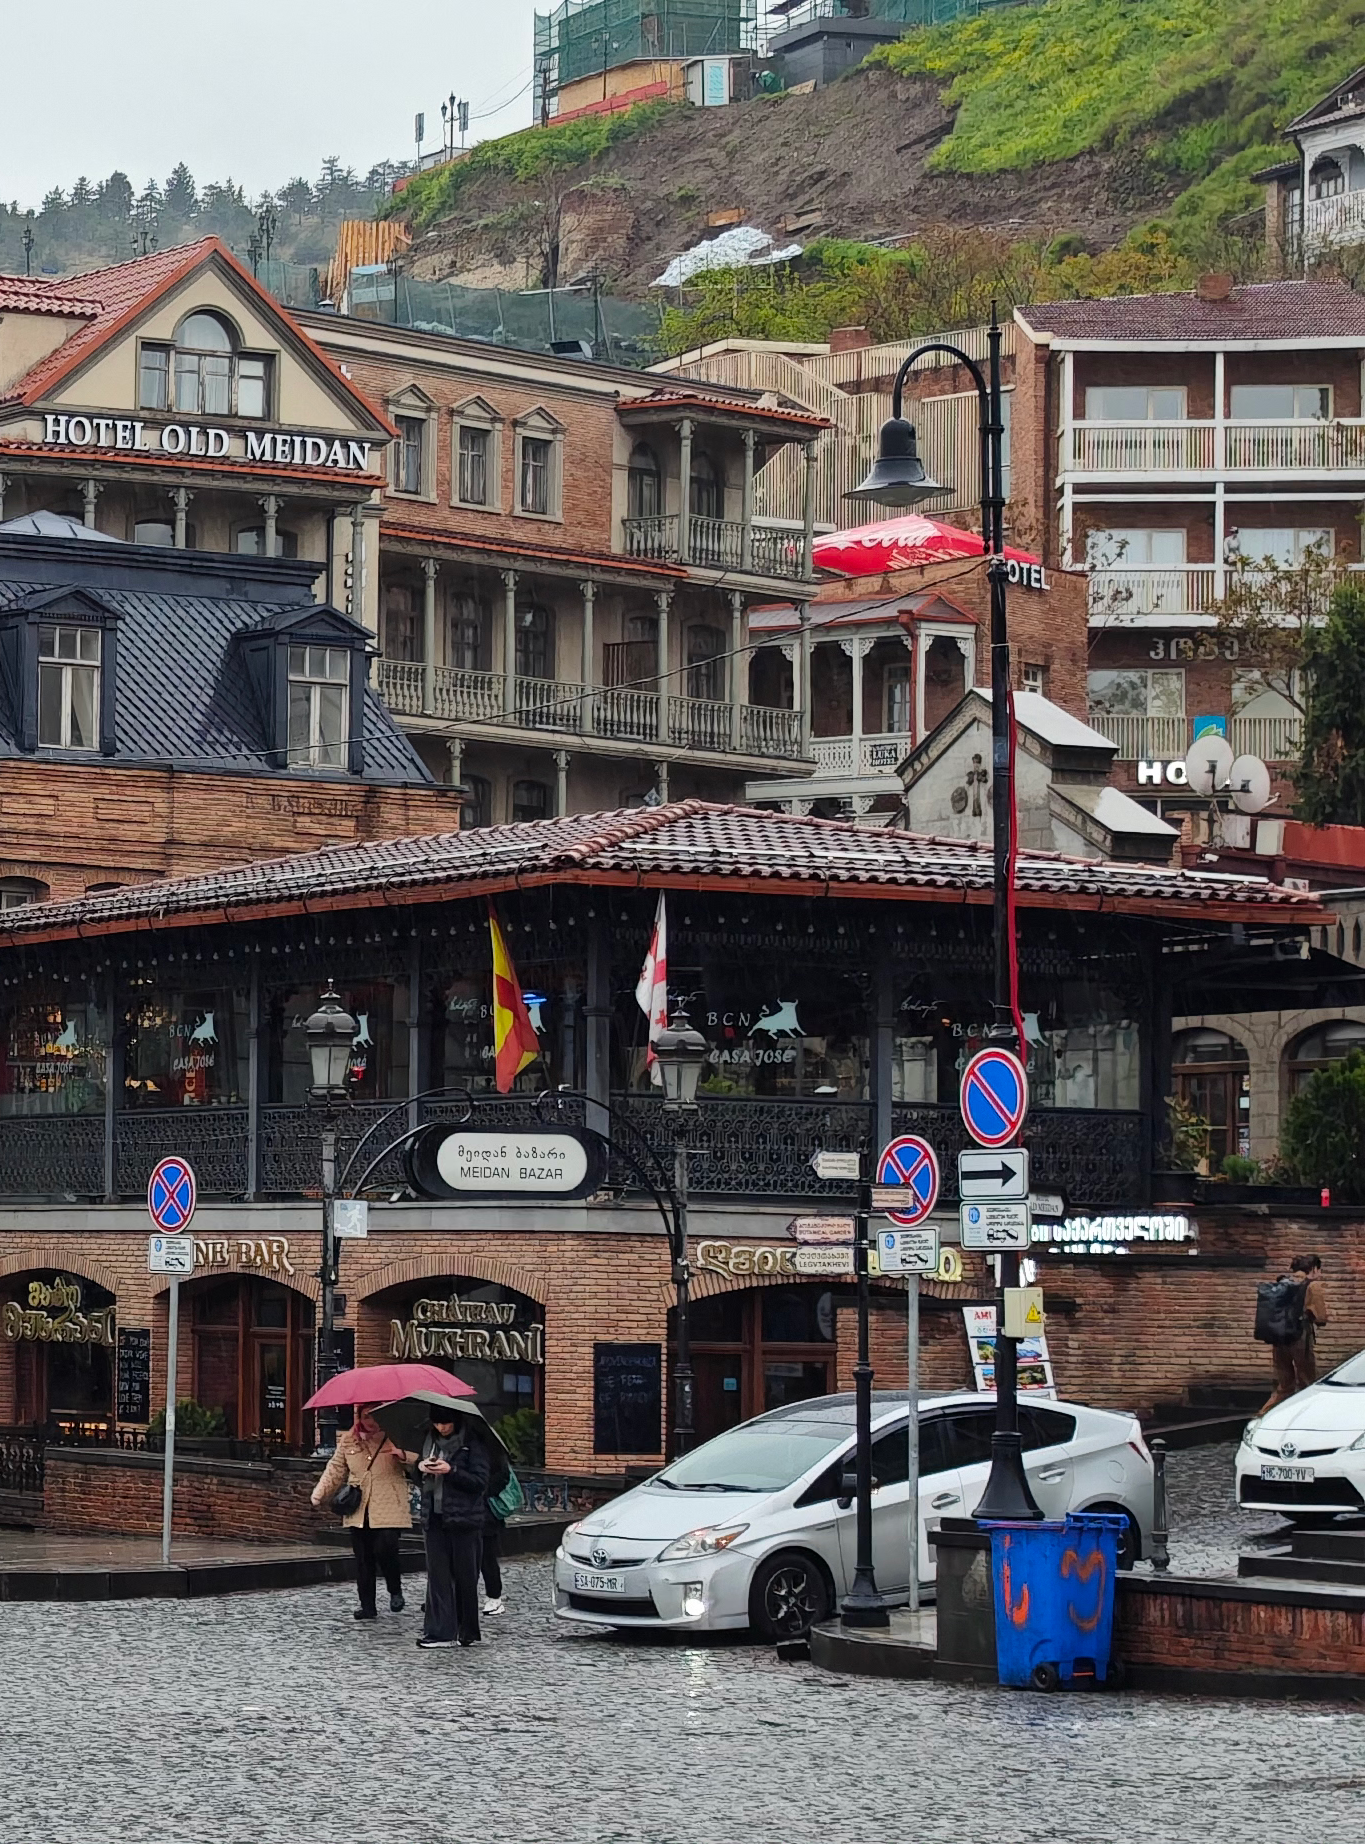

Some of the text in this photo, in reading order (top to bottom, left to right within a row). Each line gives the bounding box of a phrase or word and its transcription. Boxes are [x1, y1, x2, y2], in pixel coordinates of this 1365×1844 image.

[44, 414, 371, 471] HOTEL OLD MEIDAN
[1006, 558, 1050, 591] OTEL
[706, 1011, 751, 1027] BCN
[709, 1045, 797, 1067] CASA JOSÉ
[458, 1145, 566, 1162] მეიდან ბაზარი
[460, 1166, 563, 1180] MEIDAN BAZAR
[237, 1236, 295, 1276] BAR
[389, 1319, 544, 1364] MUKHRANI
